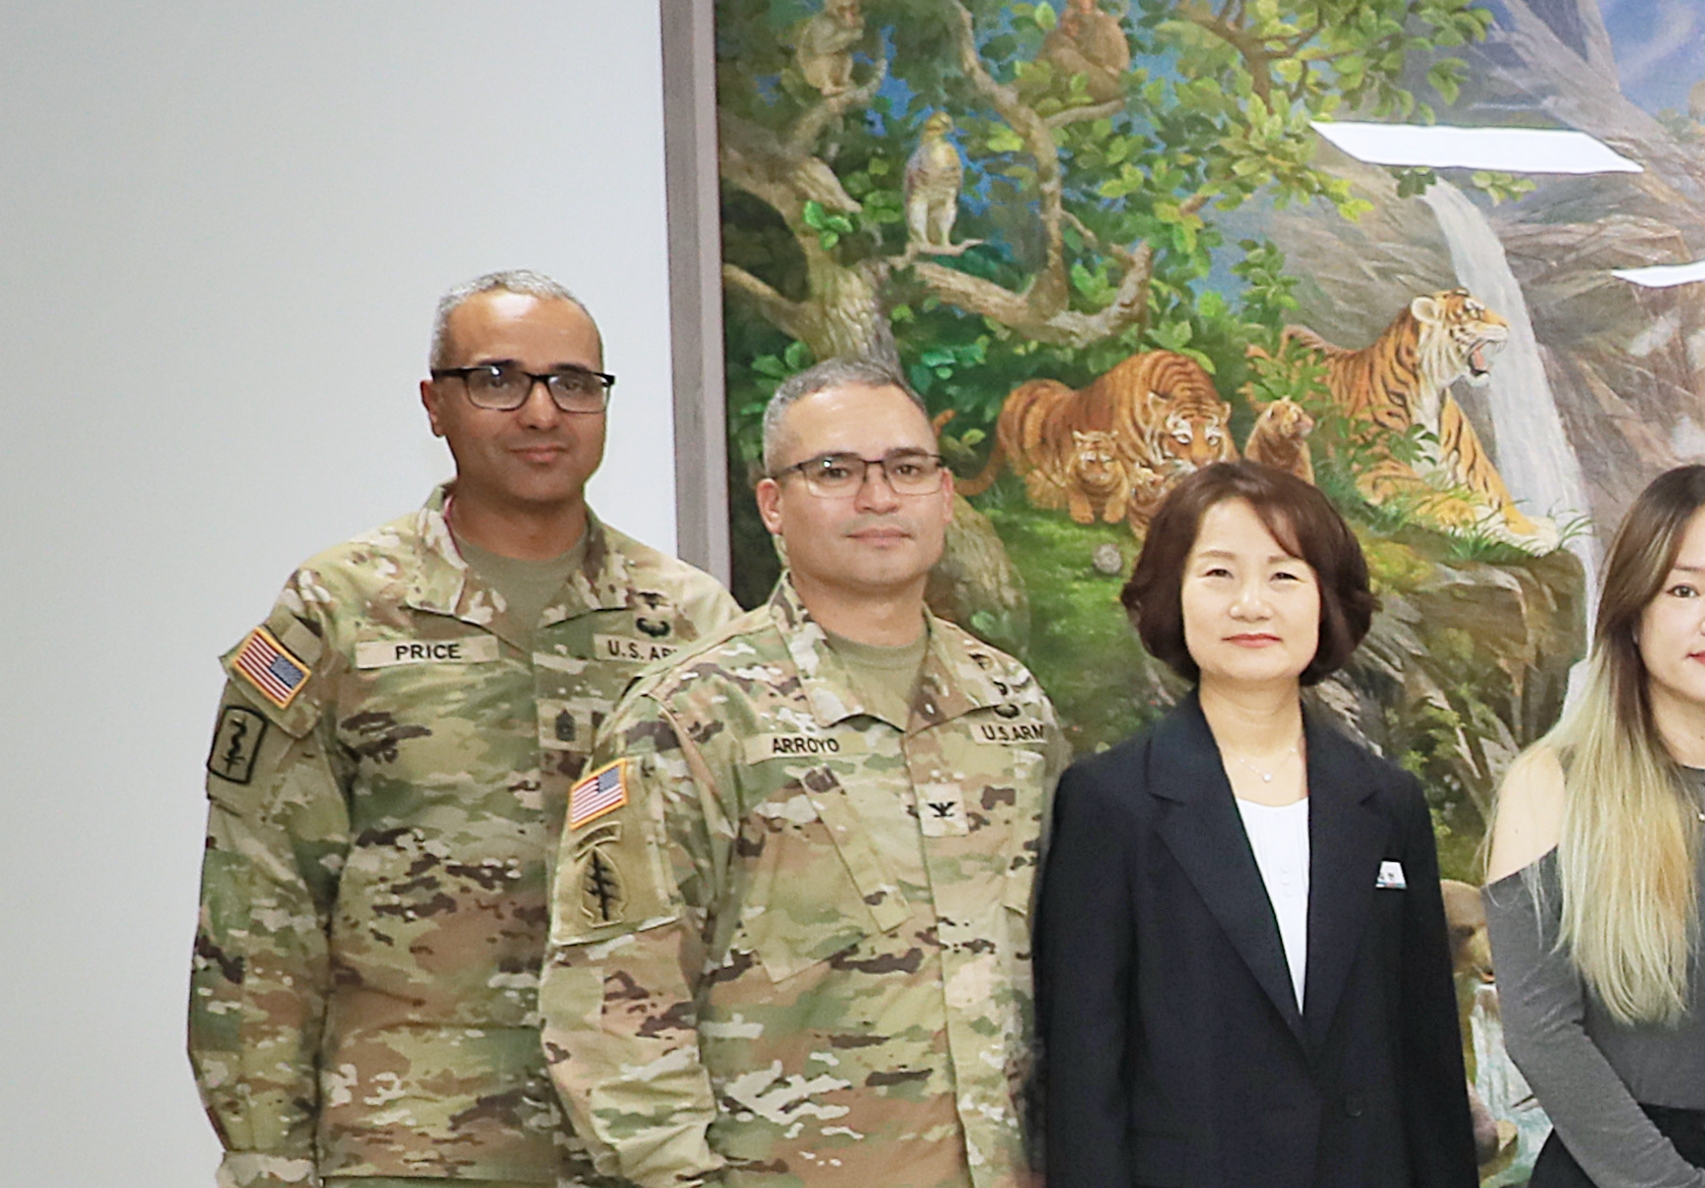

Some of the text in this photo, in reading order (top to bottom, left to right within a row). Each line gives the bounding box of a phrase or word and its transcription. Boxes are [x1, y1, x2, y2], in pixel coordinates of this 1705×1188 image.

[395, 644, 462, 660] PRICE
[649, 648, 677, 661] AR
[771, 737, 840, 754] ARROYO
